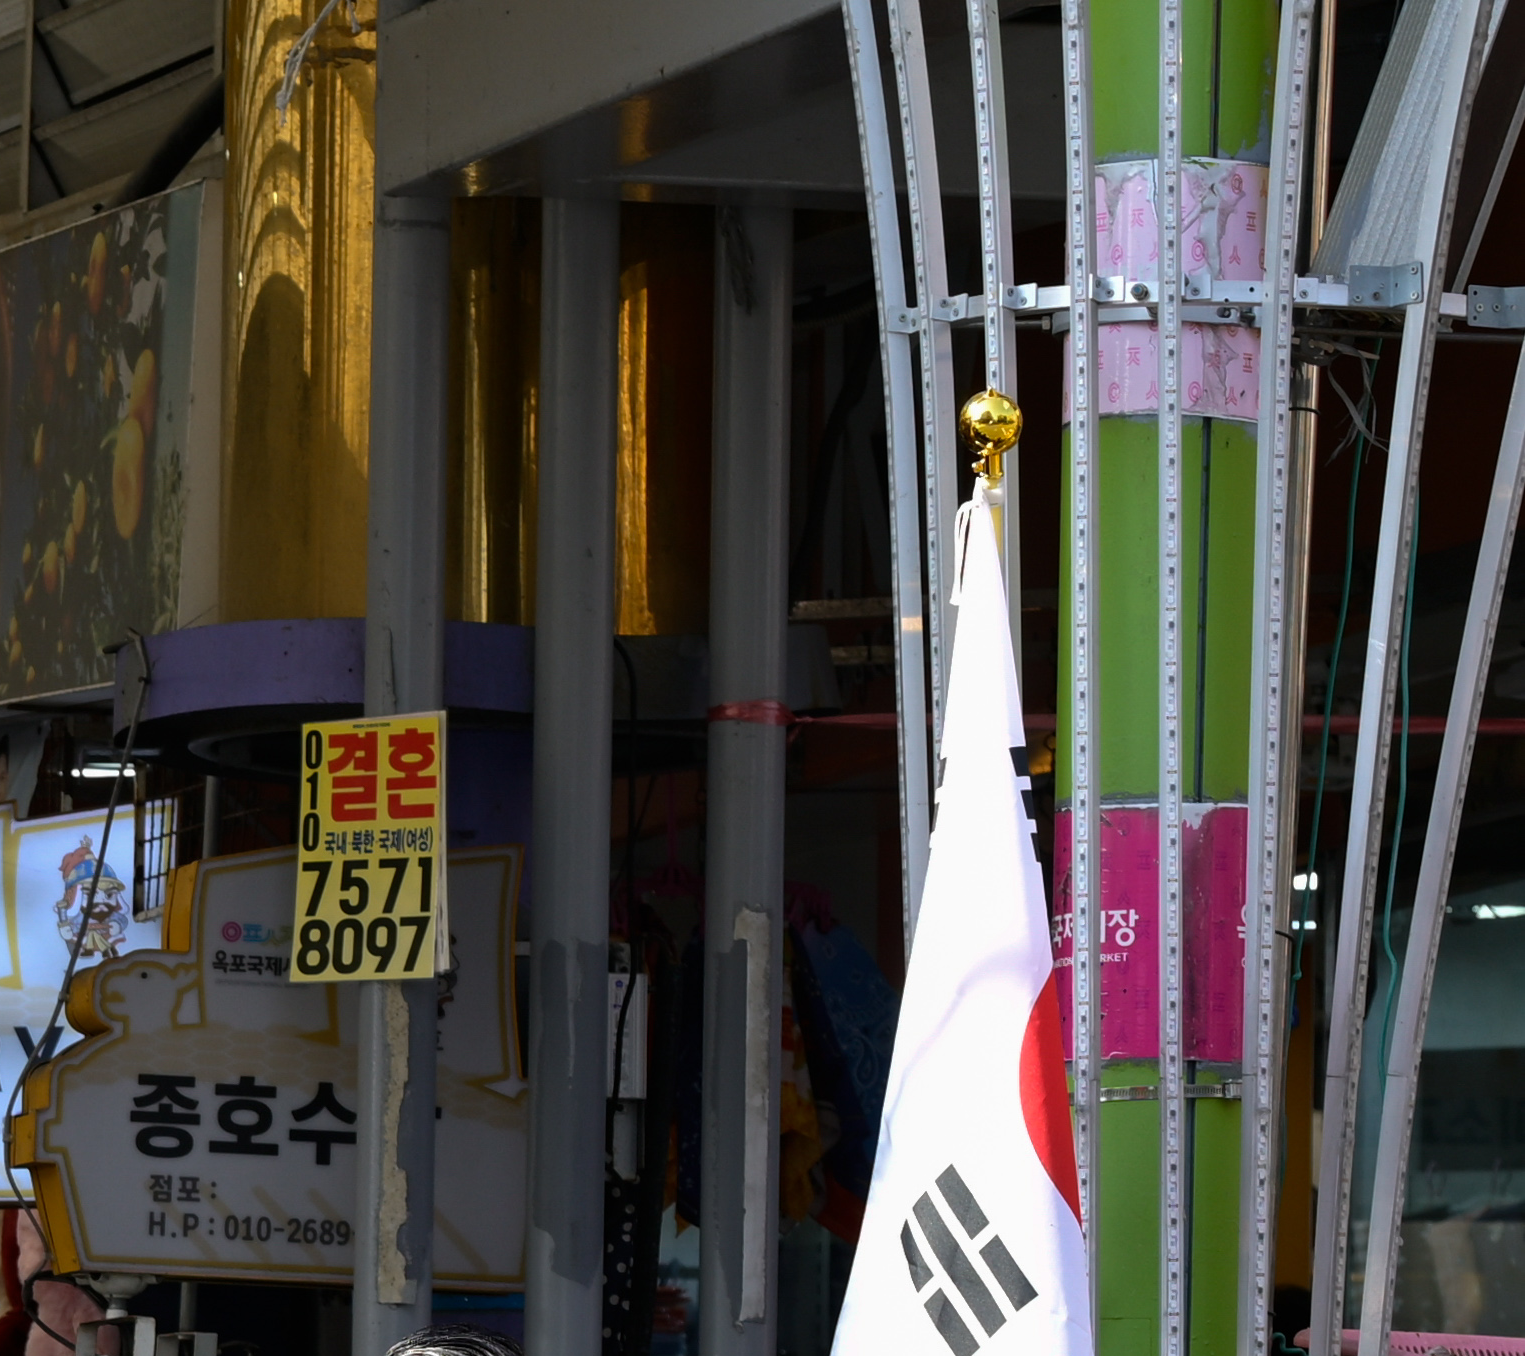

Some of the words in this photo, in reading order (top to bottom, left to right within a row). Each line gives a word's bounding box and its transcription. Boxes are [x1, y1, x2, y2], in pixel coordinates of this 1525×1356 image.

[327, 727, 438, 823] 결혼
[301, 856, 433, 917] 7571
[296, 915, 432, 976] 8097
[129, 1073, 359, 1166] 종호수
